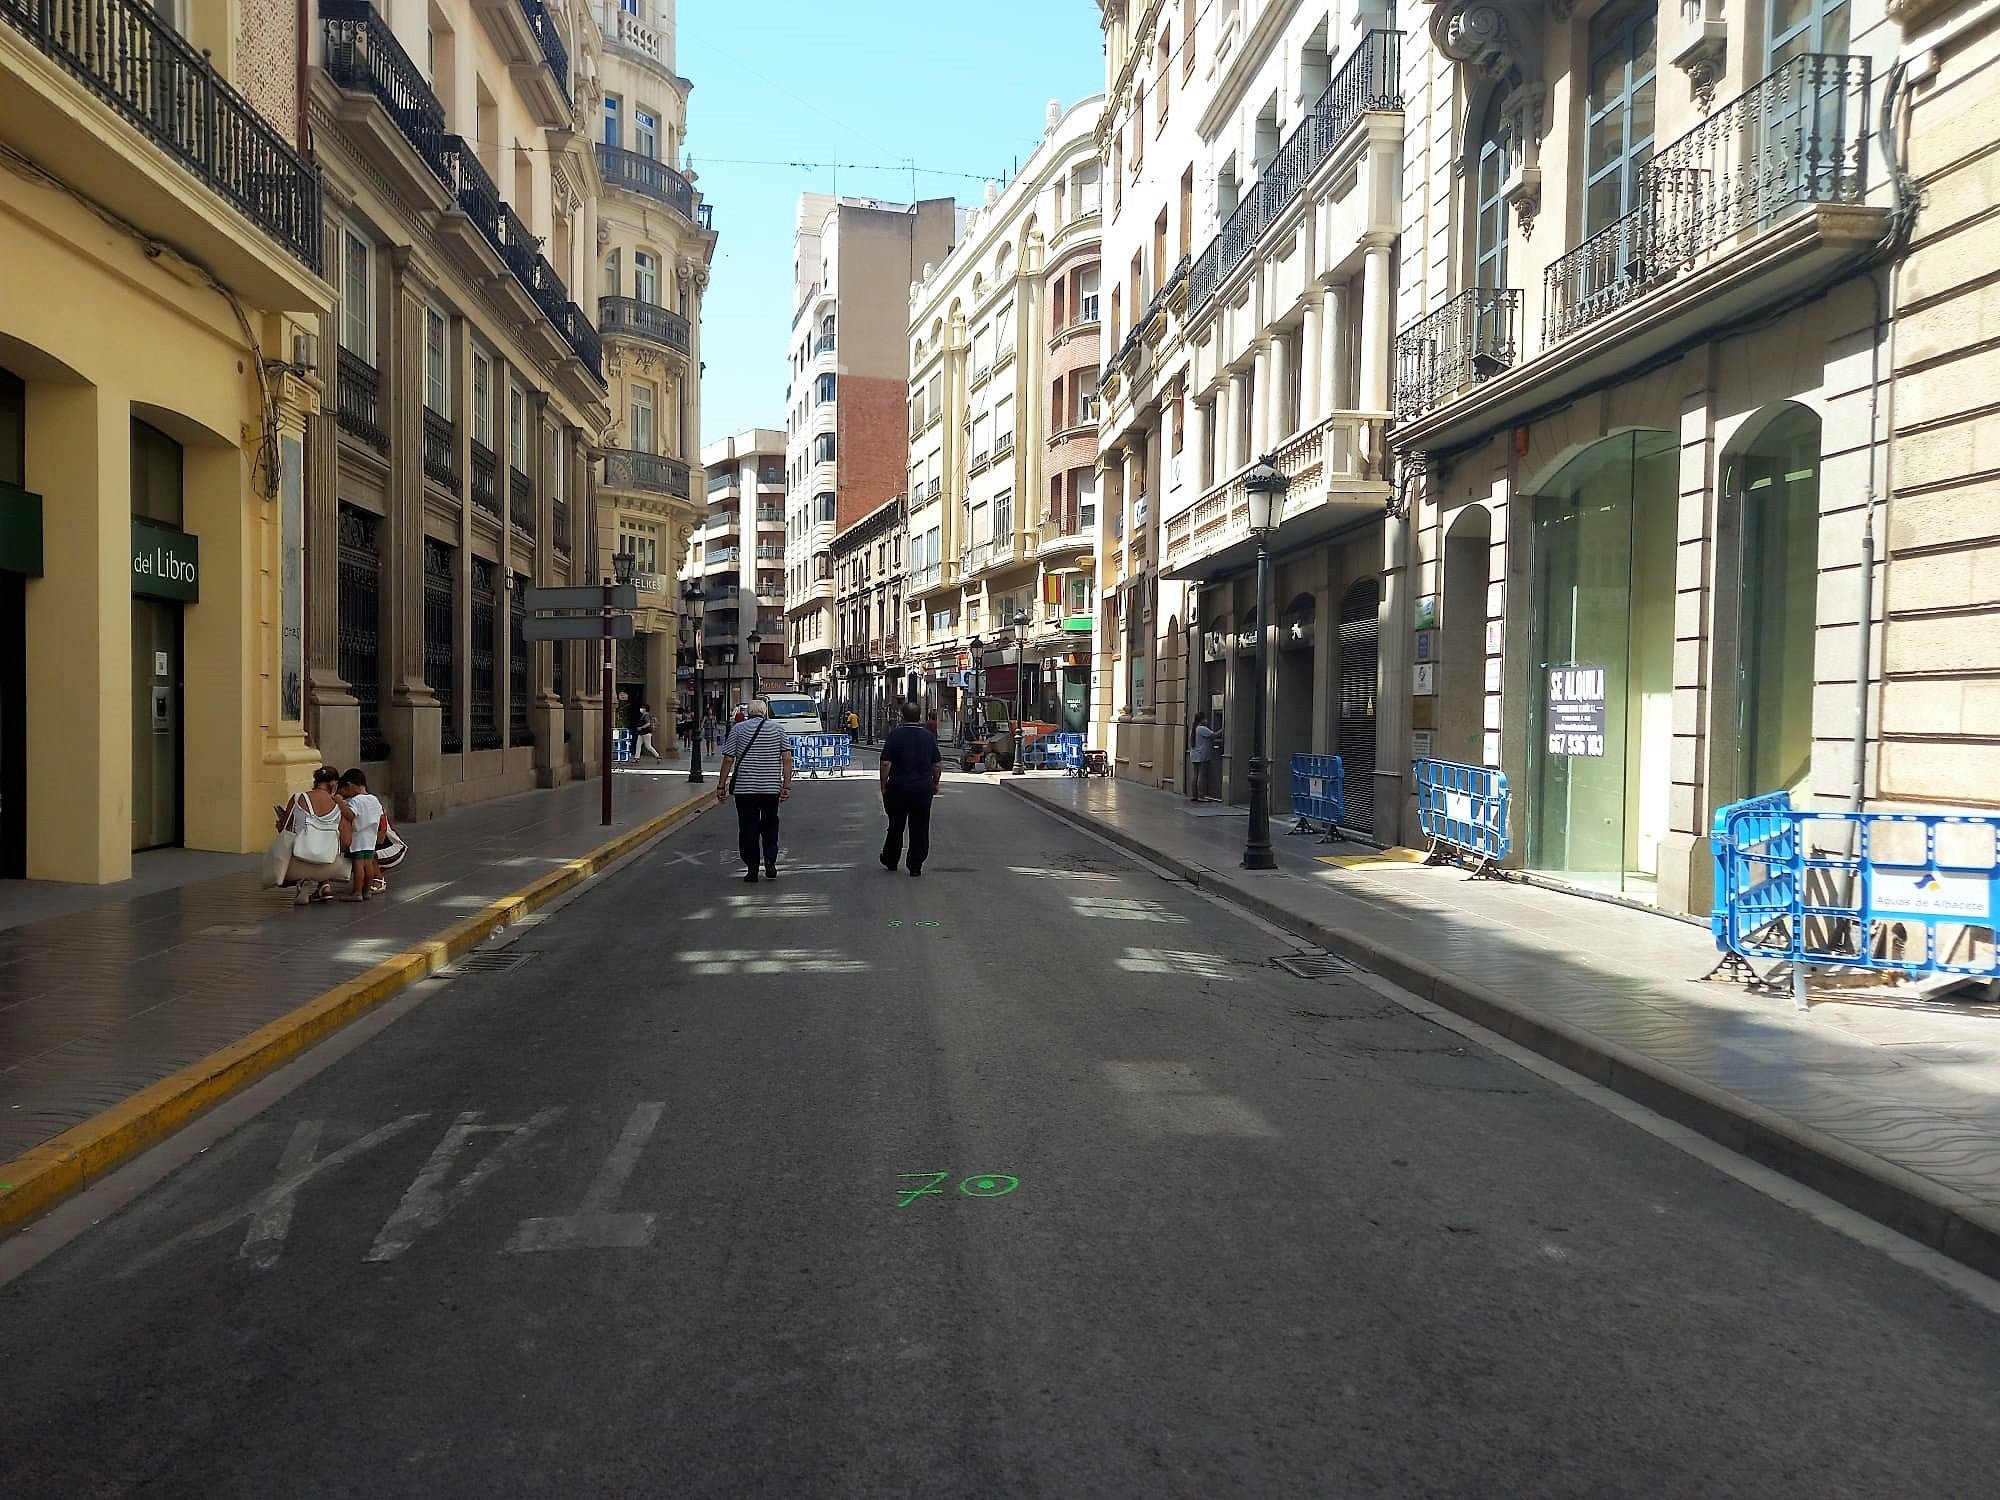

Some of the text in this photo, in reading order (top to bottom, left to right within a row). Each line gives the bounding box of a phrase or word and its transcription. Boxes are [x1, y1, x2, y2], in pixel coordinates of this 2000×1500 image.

[134, 547, 195, 583] del Libro
[1551, 669, 1604, 704] SE ALQUILA
[1877, 896, 1985, 911] Aguas de Albacete
